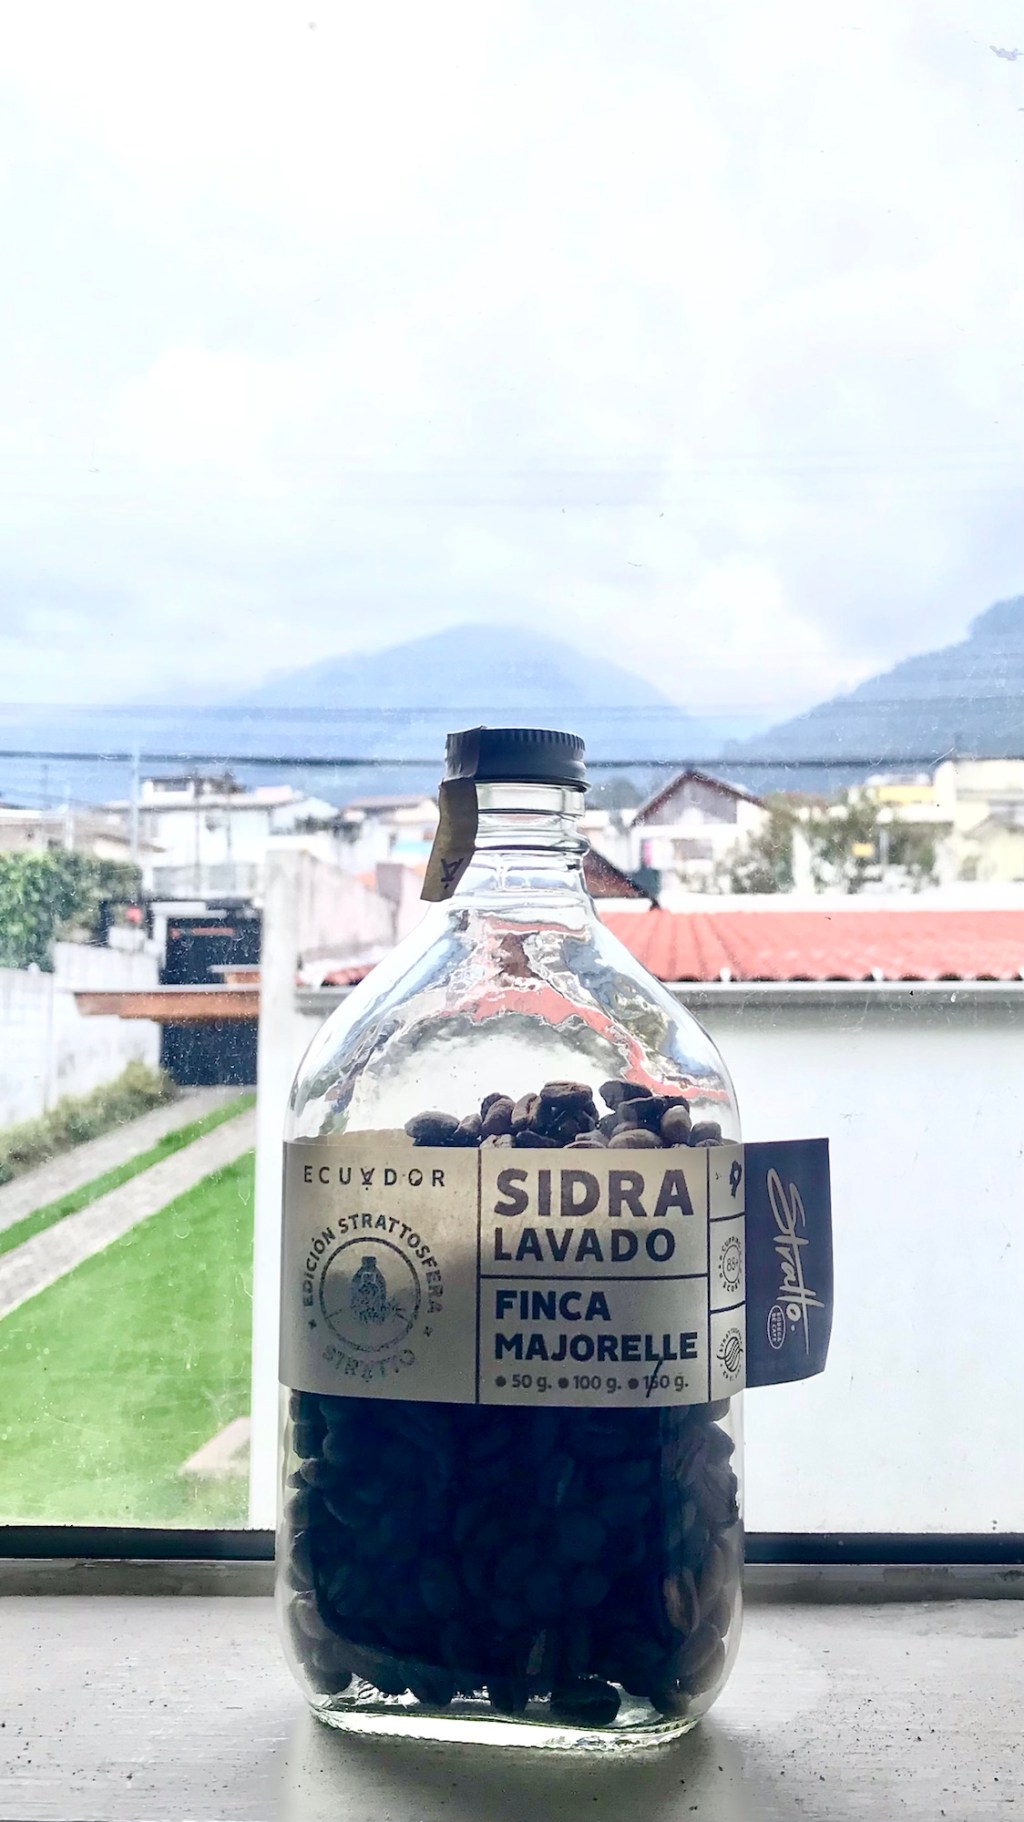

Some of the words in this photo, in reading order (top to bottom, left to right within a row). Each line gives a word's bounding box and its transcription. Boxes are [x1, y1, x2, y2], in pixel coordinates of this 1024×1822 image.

[494, 1168, 694, 1217] SIDRA
[494, 1228, 676, 1262] LAVADO
[303, 1227, 336, 1307] EDICIÓN
[338, 1213, 444, 1314] STRATTOSFERA
[496, 1290, 612, 1321] FINCA
[494, 1332, 698, 1362] MAJORELLE
[511, 1374, 532, 1388] 50
[573, 1375, 601, 1390] 100
[643, 1375, 670, 1390] 150
